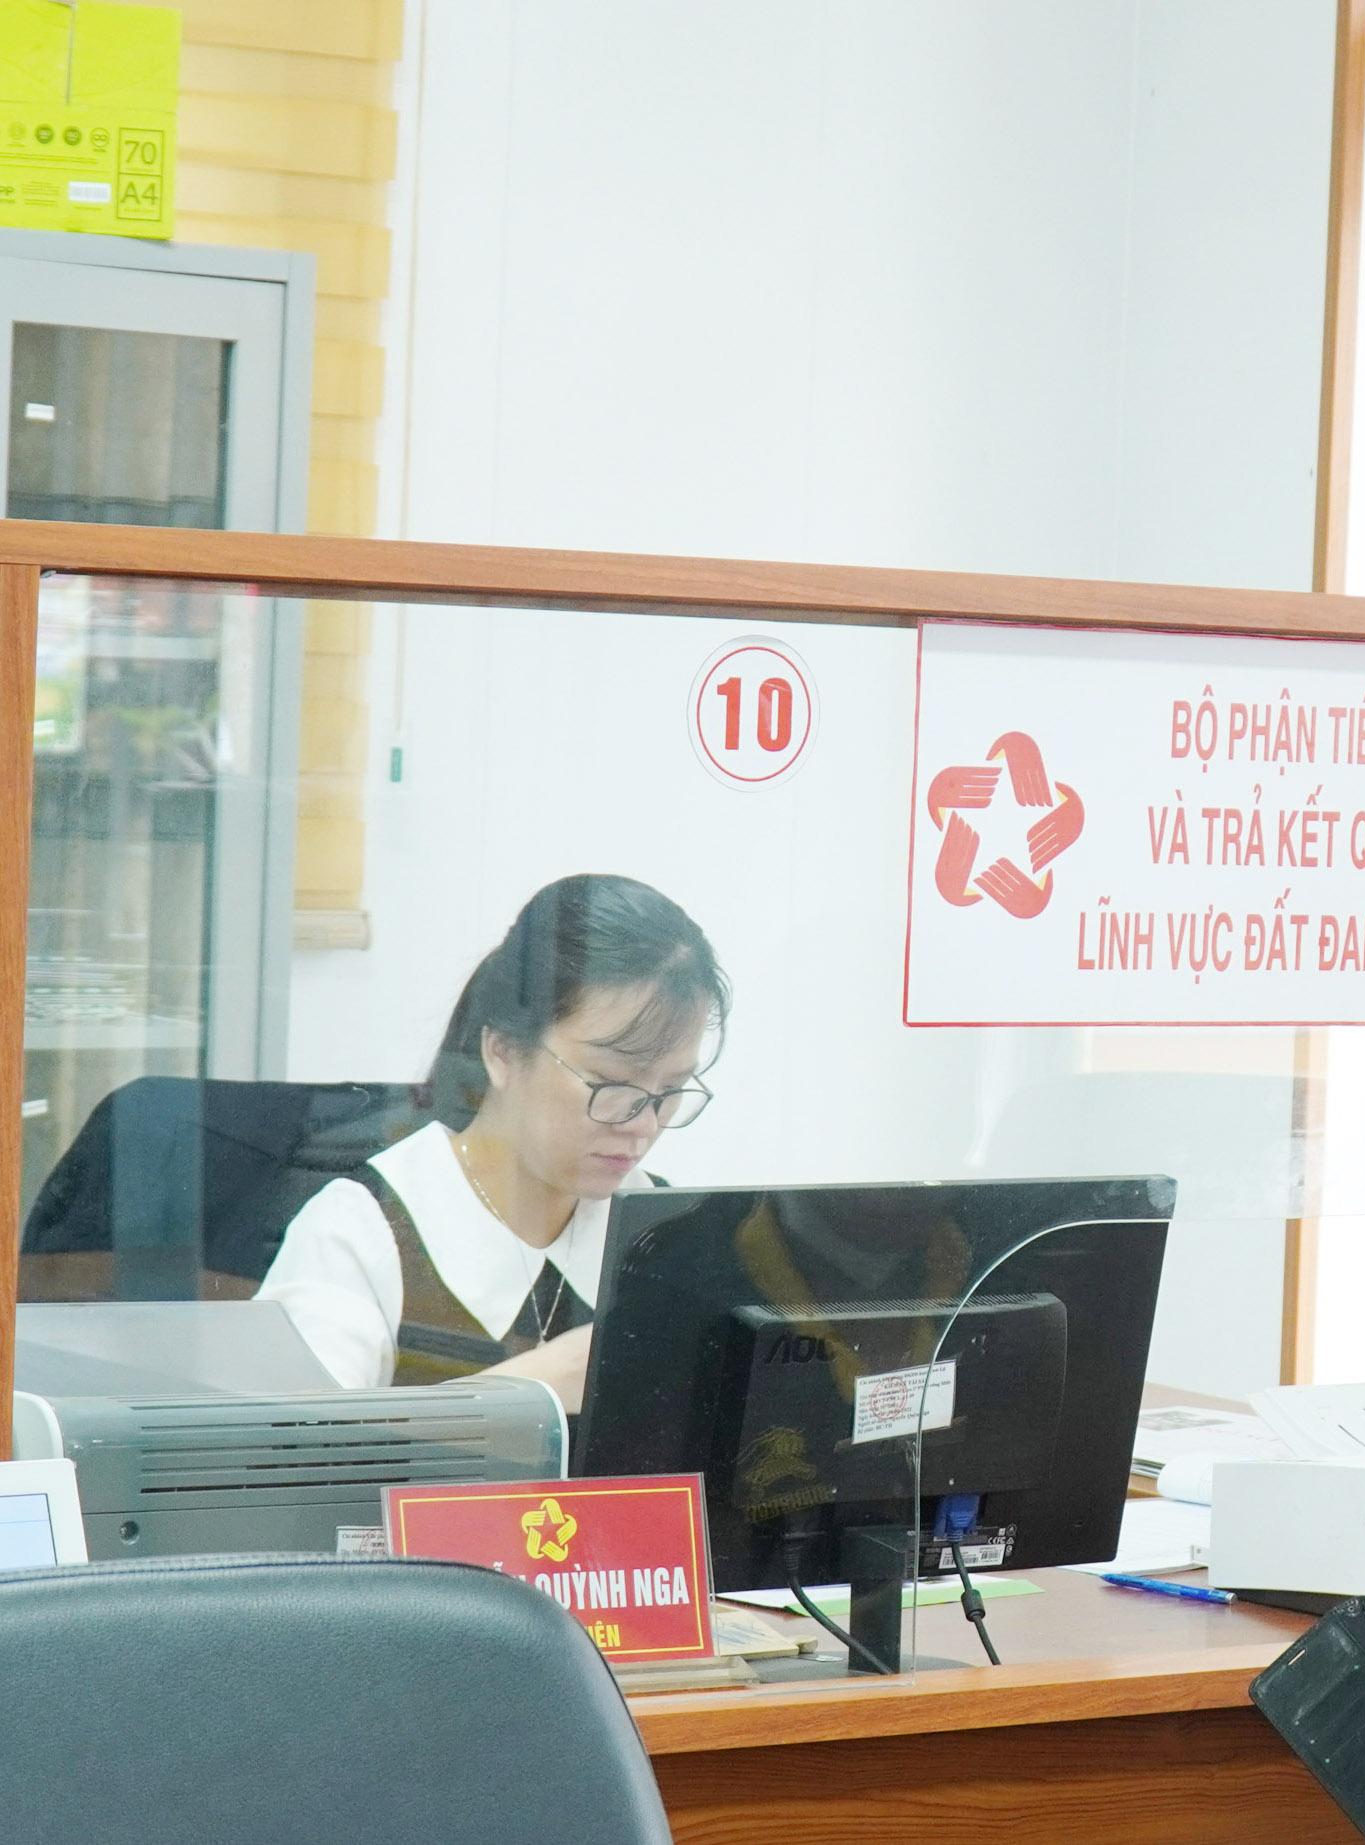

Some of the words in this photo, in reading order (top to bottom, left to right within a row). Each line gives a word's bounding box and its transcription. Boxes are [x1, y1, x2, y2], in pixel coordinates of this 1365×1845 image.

[124, 140, 157, 165] 70
[120, 181, 158, 205] A4
[716, 676, 794, 753] 10
[1171, 684, 1218, 774] BỘ
[1228, 687, 1318, 776] PHẬN
[1147, 789, 1190, 866] VÀ
[1202, 784, 1266, 866] TRẢ
[1278, 784, 1341, 868] KẾT
[1077, 895, 1155, 970] LĨNH
[1167, 904, 1234, 984] VỰC
[1244, 888, 1309, 971] ĐẤT
[535, 1563, 627, 1610] QUỲNH
[633, 1566, 690, 1606] NGA
[584, 1620, 621, 1649] IÊN
